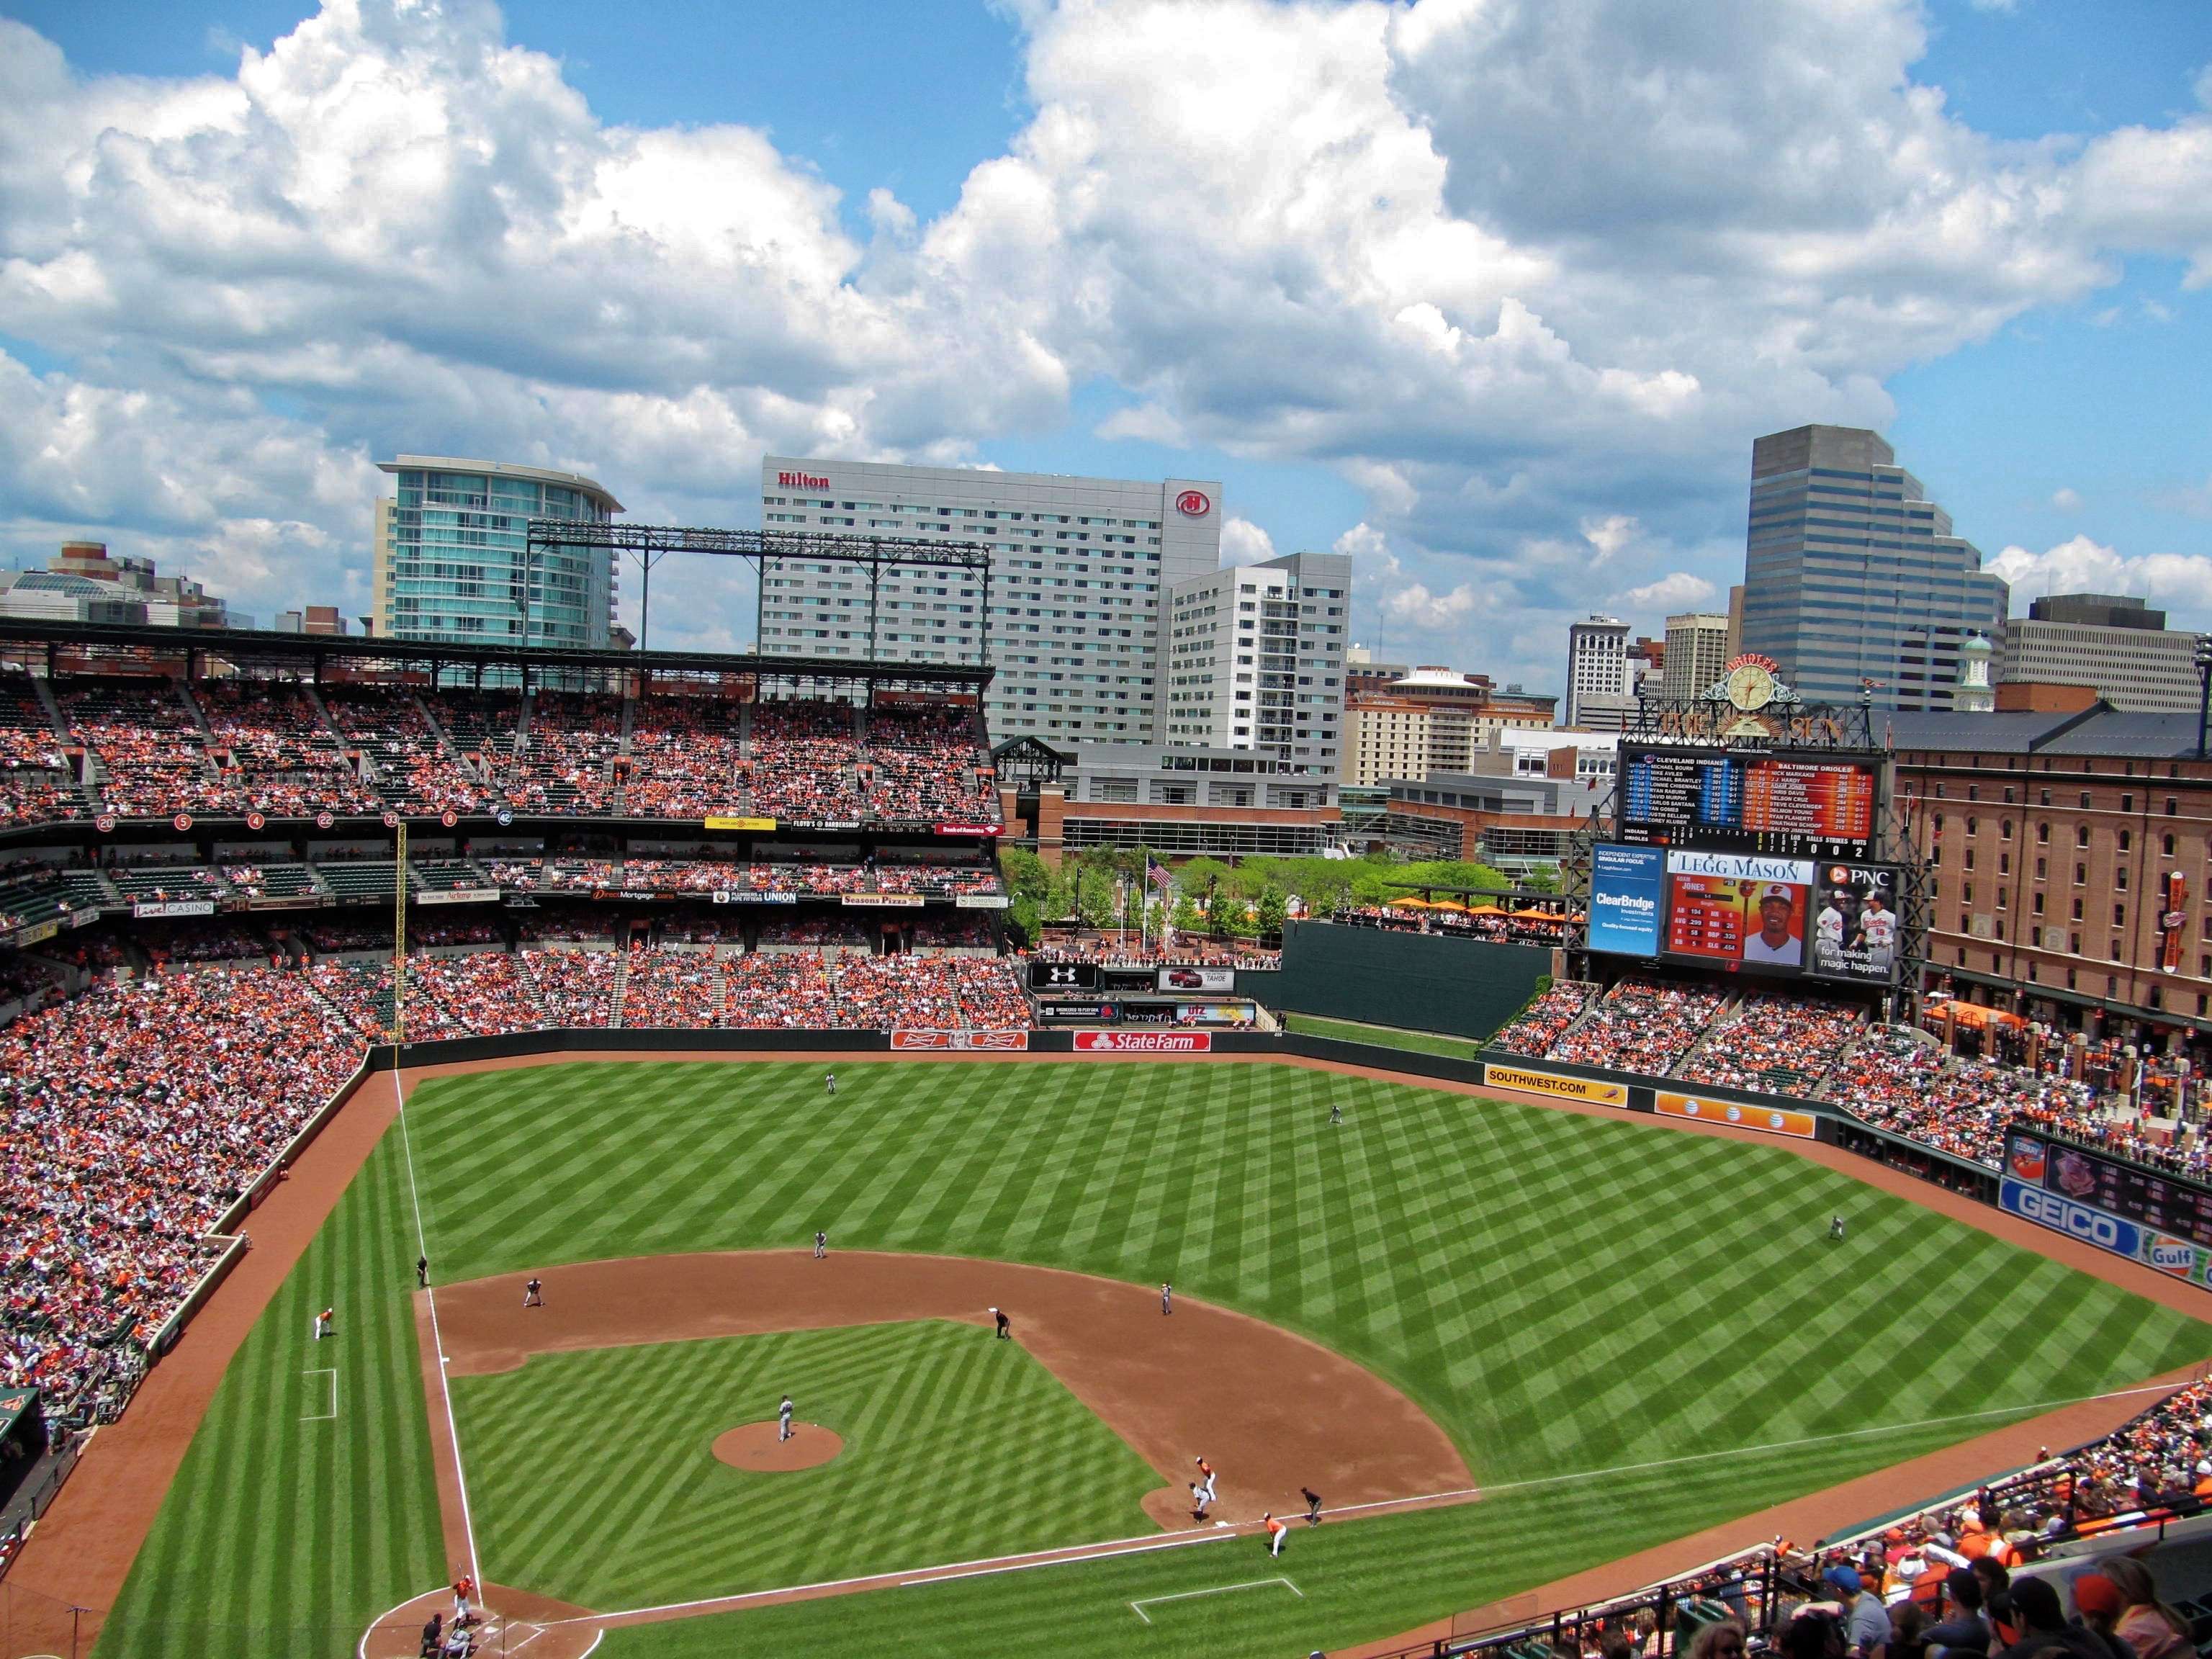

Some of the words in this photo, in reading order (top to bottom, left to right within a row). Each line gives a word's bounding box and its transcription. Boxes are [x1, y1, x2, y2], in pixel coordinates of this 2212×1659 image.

[779, 472, 830, 487] Hilton
[1727, 654, 1780, 673] ORIOLES
[1658, 711, 1709, 735] THE
[1788, 717, 1843, 739] SUN
[99, 818, 113, 828] 20
[181, 818, 186, 827] 5
[253, 817, 258, 825] 4
[447, 815, 452, 824] 8
[500, 814, 510, 822] 42
[1810, 843, 1817, 853] 0
[1833, 845, 1839, 855] 0
[1856, 848, 1863, 857] 2
[1681, 855, 1728, 874] LEGG
[1734, 860, 1799, 881] MASON
[1850, 869, 1889, 886] PNC
[1682, 882, 1705, 891] JONES
[764, 892, 796, 902] UNION
[1596, 893, 1655, 911] ClearBridge
[136, 904, 166, 917] Live!
[167, 903, 212, 913] CASINO
[1621, 908, 1654, 917] Investments
[1822, 947, 1836, 956] for
[1837, 949, 1872, 962] making
[1820, 959, 1849, 971] magic
[1851, 961, 1889, 974] happen.
[1116, 1034, 1155, 1049] State
[1156, 1036, 1194, 1049] Farm
[1489, 1071, 1586, 1094] SOUTHWEST.COM
[2018, 1188, 2118, 1246] GEICO
[2153, 1247, 2190, 1264] Gulf
